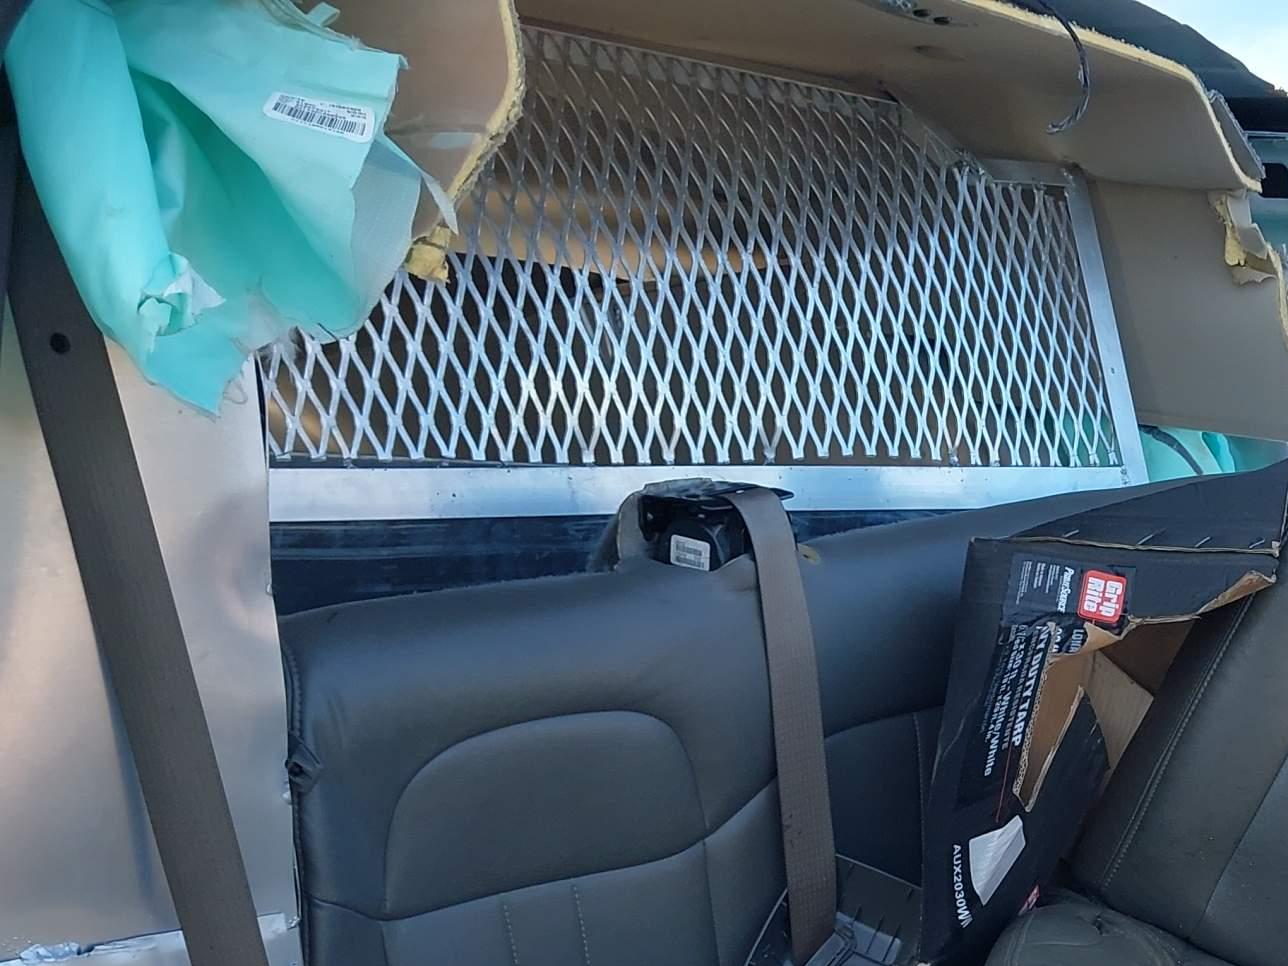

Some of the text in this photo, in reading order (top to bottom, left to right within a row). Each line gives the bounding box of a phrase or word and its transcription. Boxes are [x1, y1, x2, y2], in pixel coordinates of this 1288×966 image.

[1083, 577, 1105, 612] Rite
[1099, 581, 1123, 617] Grip
[1022, 652, 1044, 697] DUTY
[984, 691, 1013, 776] White/White
[1011, 698, 1031, 747] TARP
